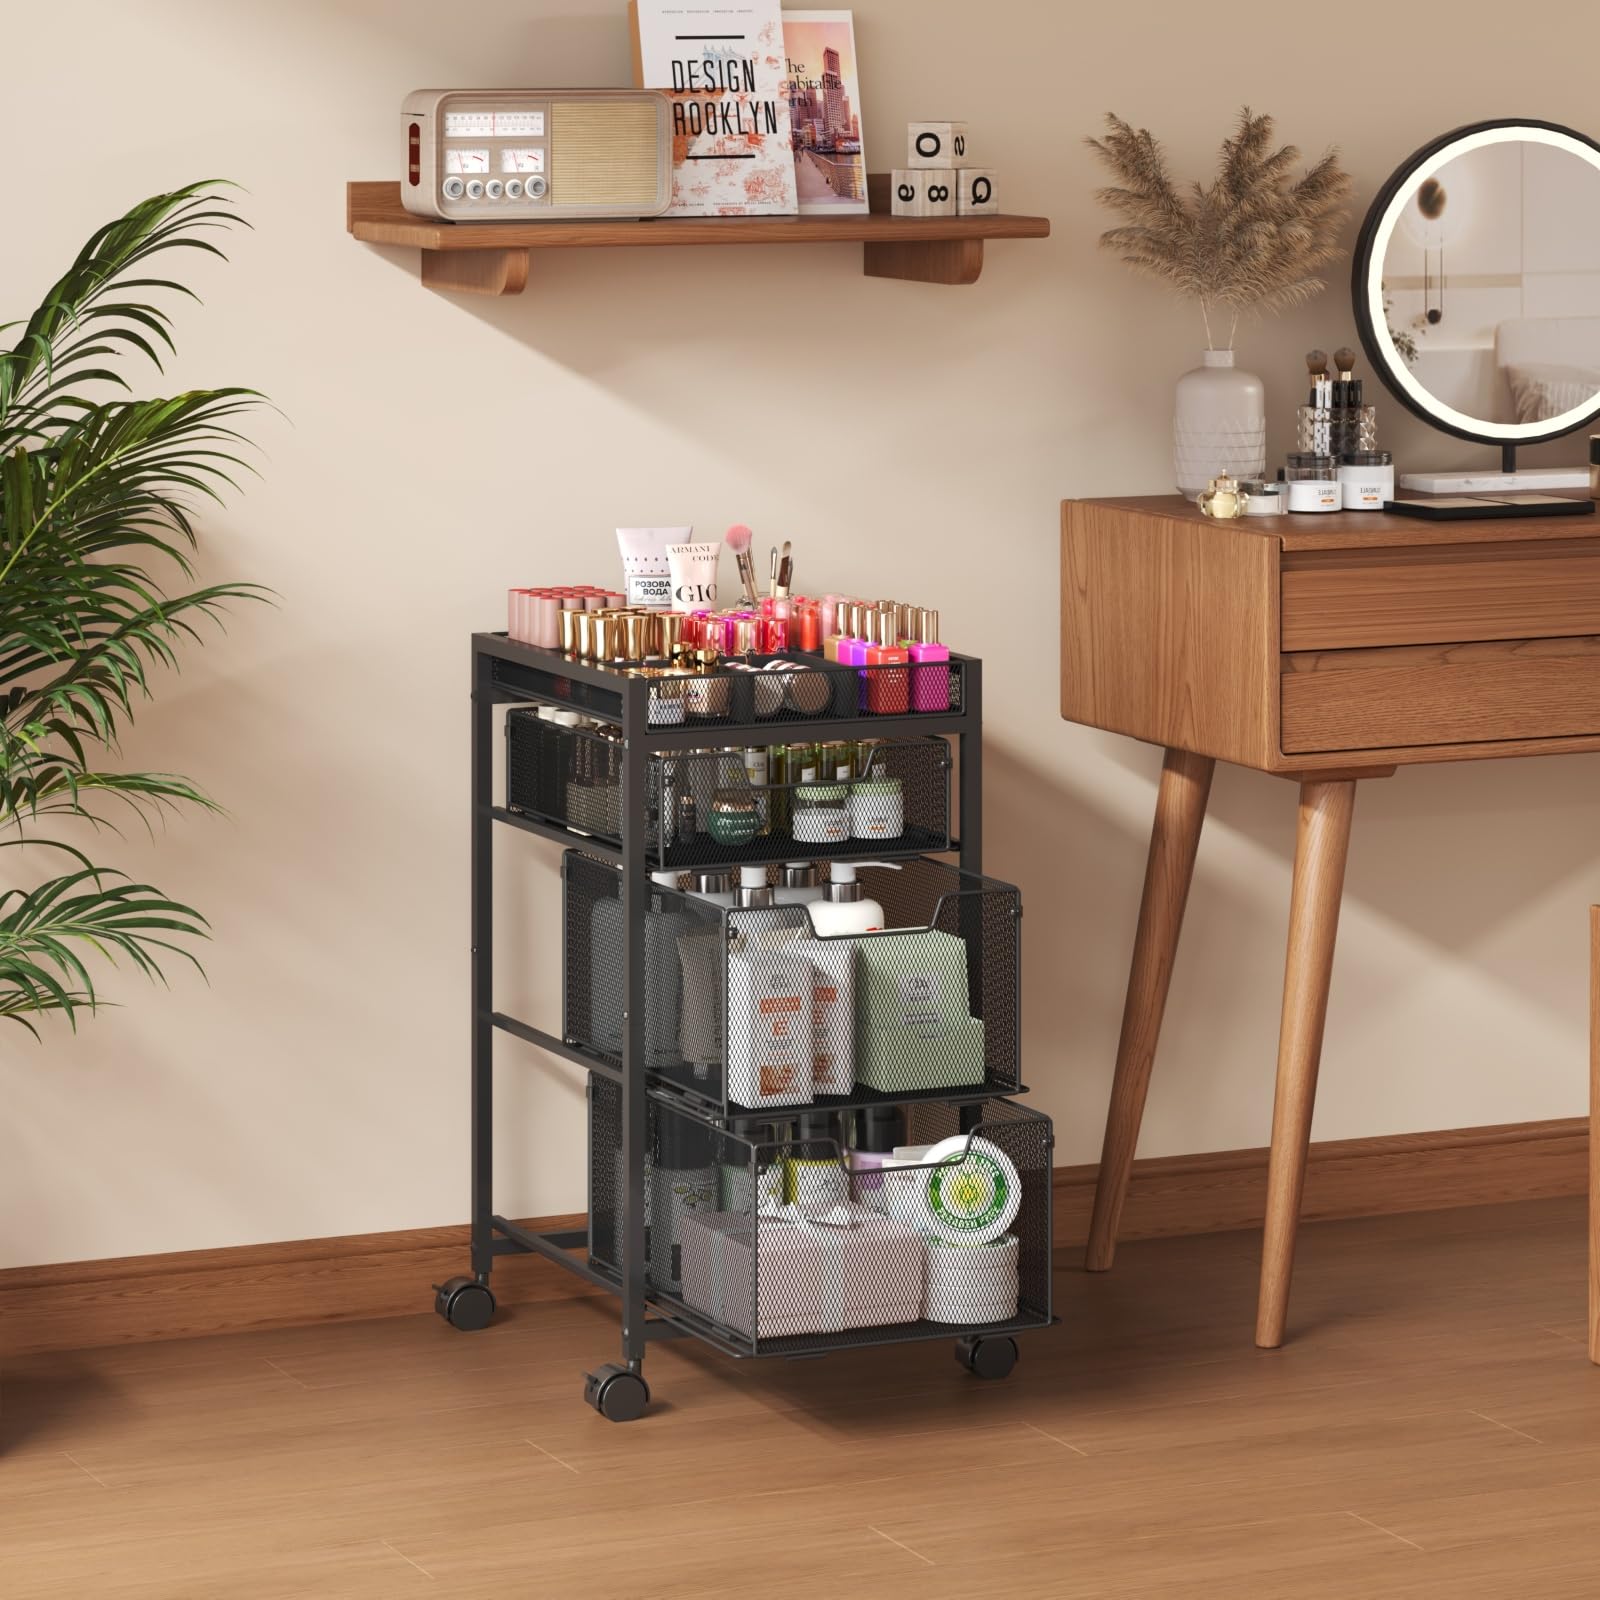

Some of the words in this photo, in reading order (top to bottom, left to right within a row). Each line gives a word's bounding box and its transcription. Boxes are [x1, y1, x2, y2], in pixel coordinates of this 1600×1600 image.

[785, 58, 805, 73] he
[672, 59, 756, 93] DESIGN
[673, 101, 777, 136] ROOKLYN
[671, 545, 710, 553] ARMANI
[635, 580, 671, 588] РОЗОВА
